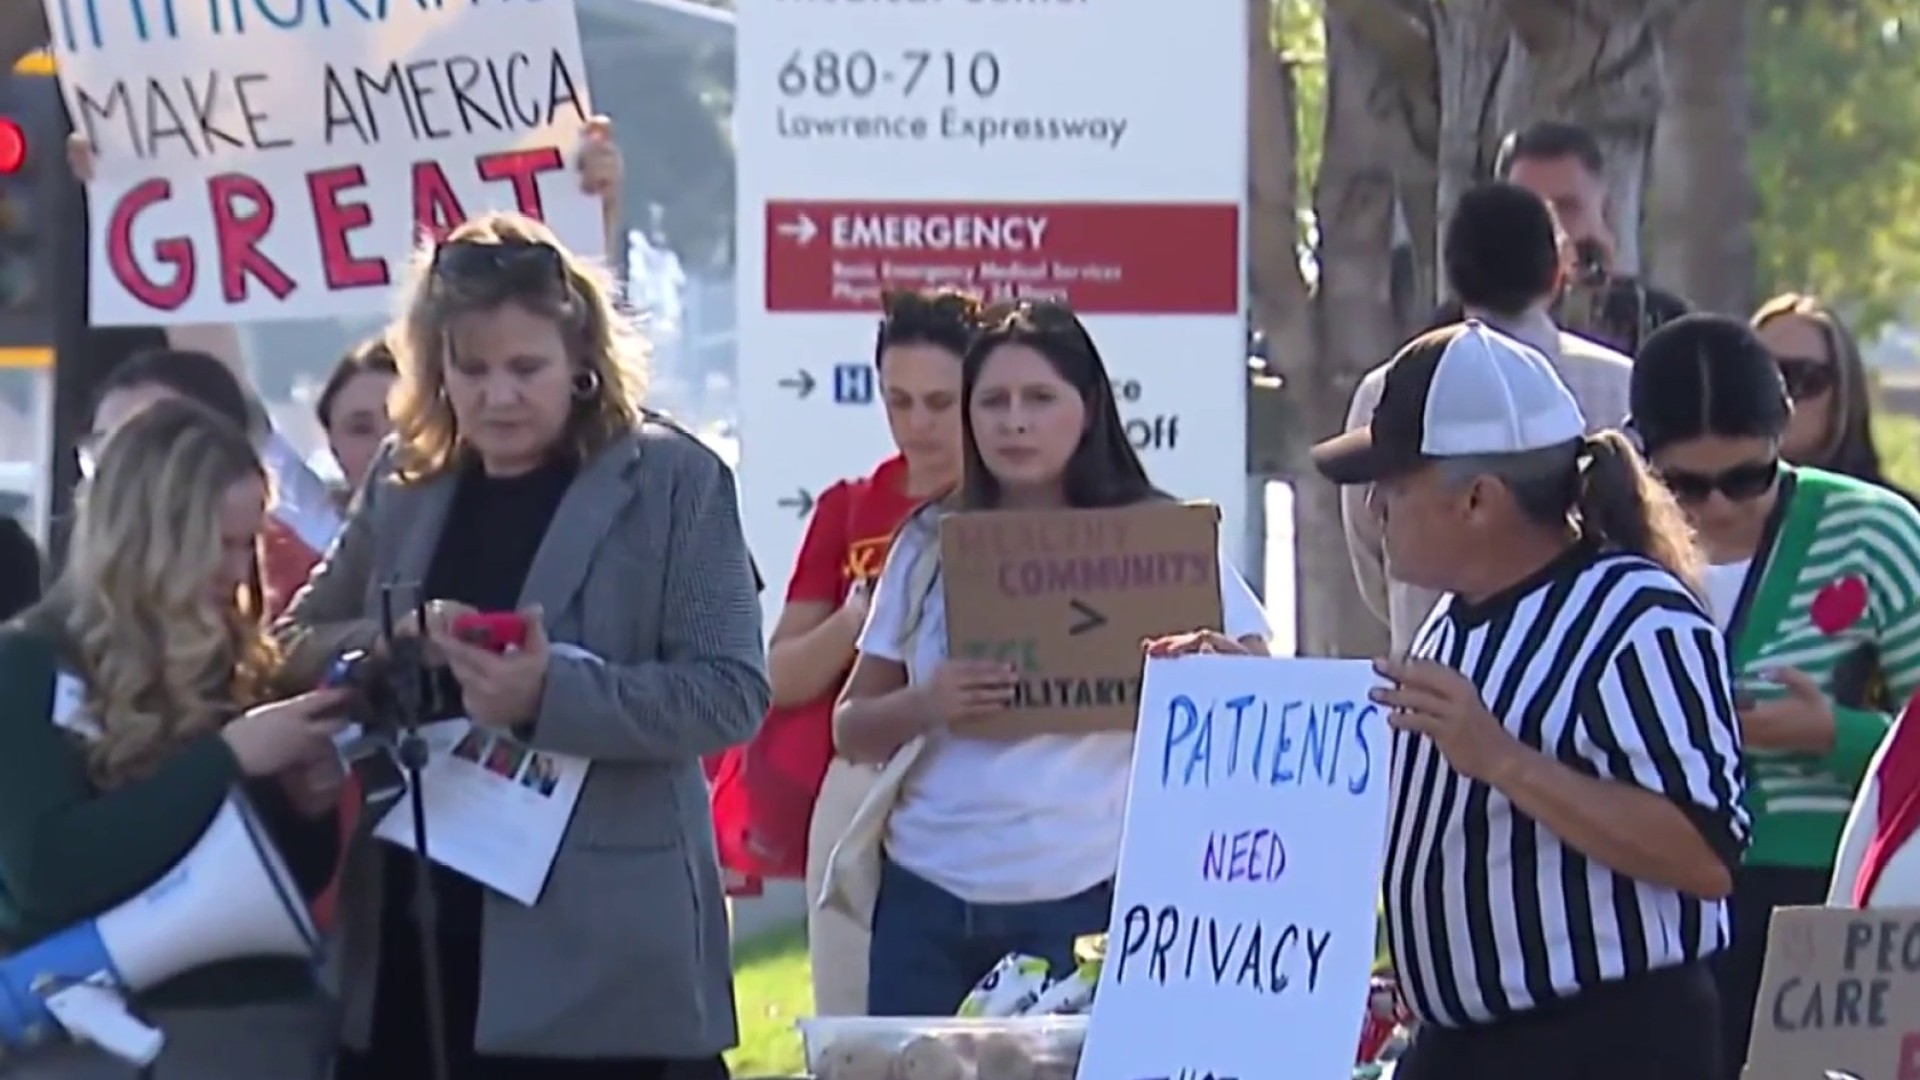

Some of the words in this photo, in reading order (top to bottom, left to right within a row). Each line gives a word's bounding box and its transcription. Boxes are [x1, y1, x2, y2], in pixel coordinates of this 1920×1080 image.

[777, 49, 1000, 98] 680-710
[73, 70, 294, 160] MAKE
[322, 48, 587, 145] AMERICA
[777, 107, 927, 140] Lawrence
[941, 107, 1127, 148] Expressway
[107, 146, 563, 311] GREAT
[832, 216, 1047, 249] EMERGENCY
[881, 260, 974, 283] Emergency
[979, 260, 1047, 279] Medical
[1053, 260, 1122, 280] Services
[1000, 553, 1210, 597] COMMUNITY
[1162, 693, 1378, 795] PATIENTS
[1203, 828, 1287, 884] NEED
[1117, 904, 1332, 994] PRIVACY
[1772, 976, 1891, 1032] CARE
